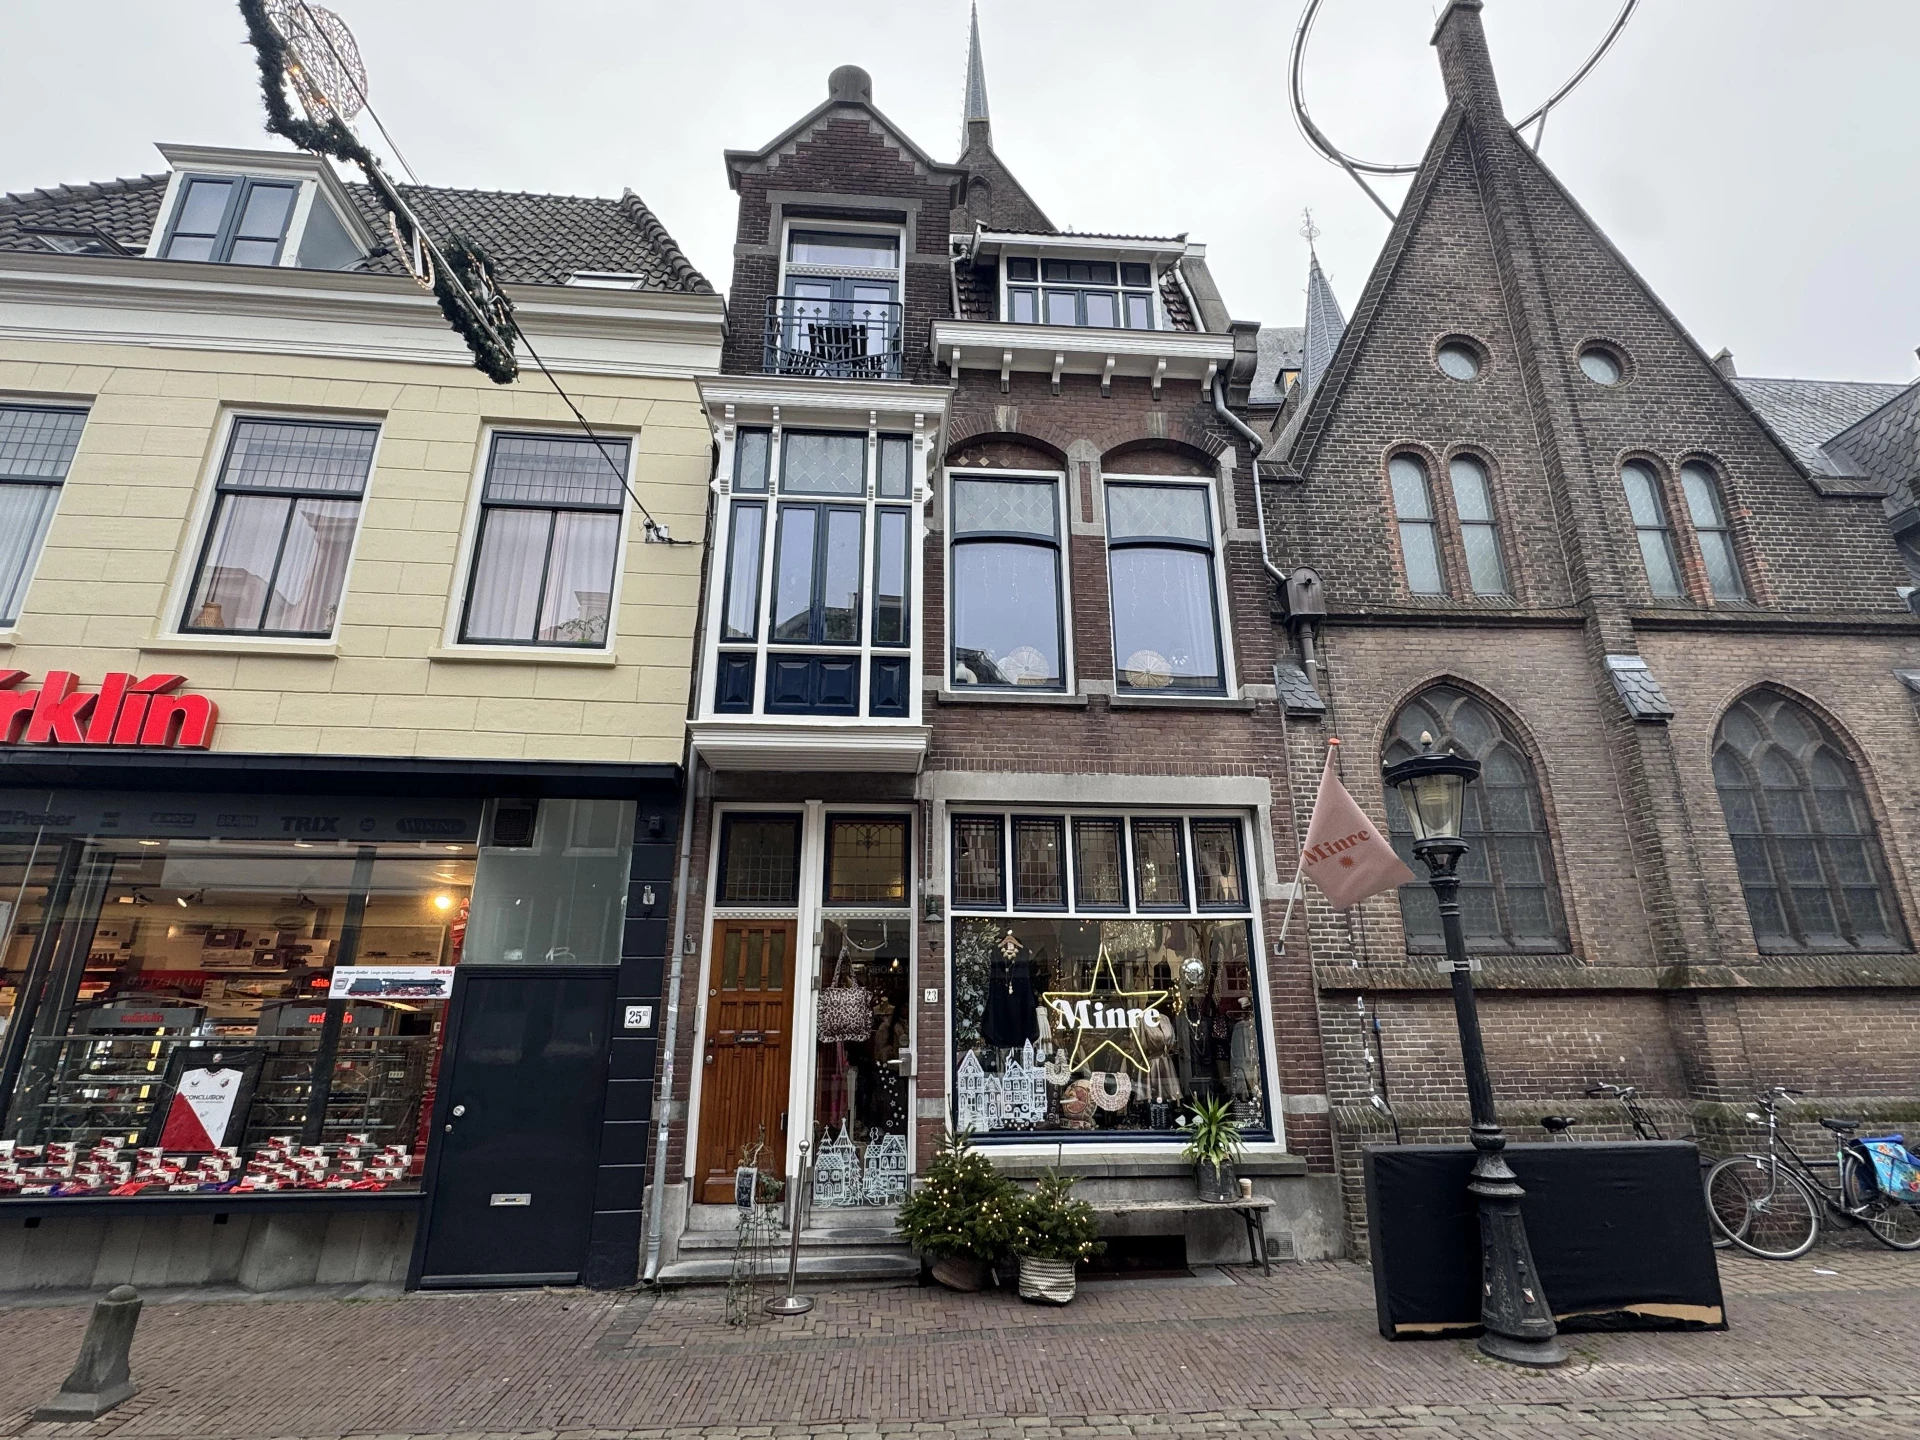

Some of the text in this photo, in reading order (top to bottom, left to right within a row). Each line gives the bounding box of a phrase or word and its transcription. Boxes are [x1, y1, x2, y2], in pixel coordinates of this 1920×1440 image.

[0, 670, 218, 750] rklin
[280, 816, 340, 833] TRIX
[1302, 829, 1371, 867] Minre
[308, 1011, 354, 1023] mäin
[1052, 998, 1161, 1030] Minre
